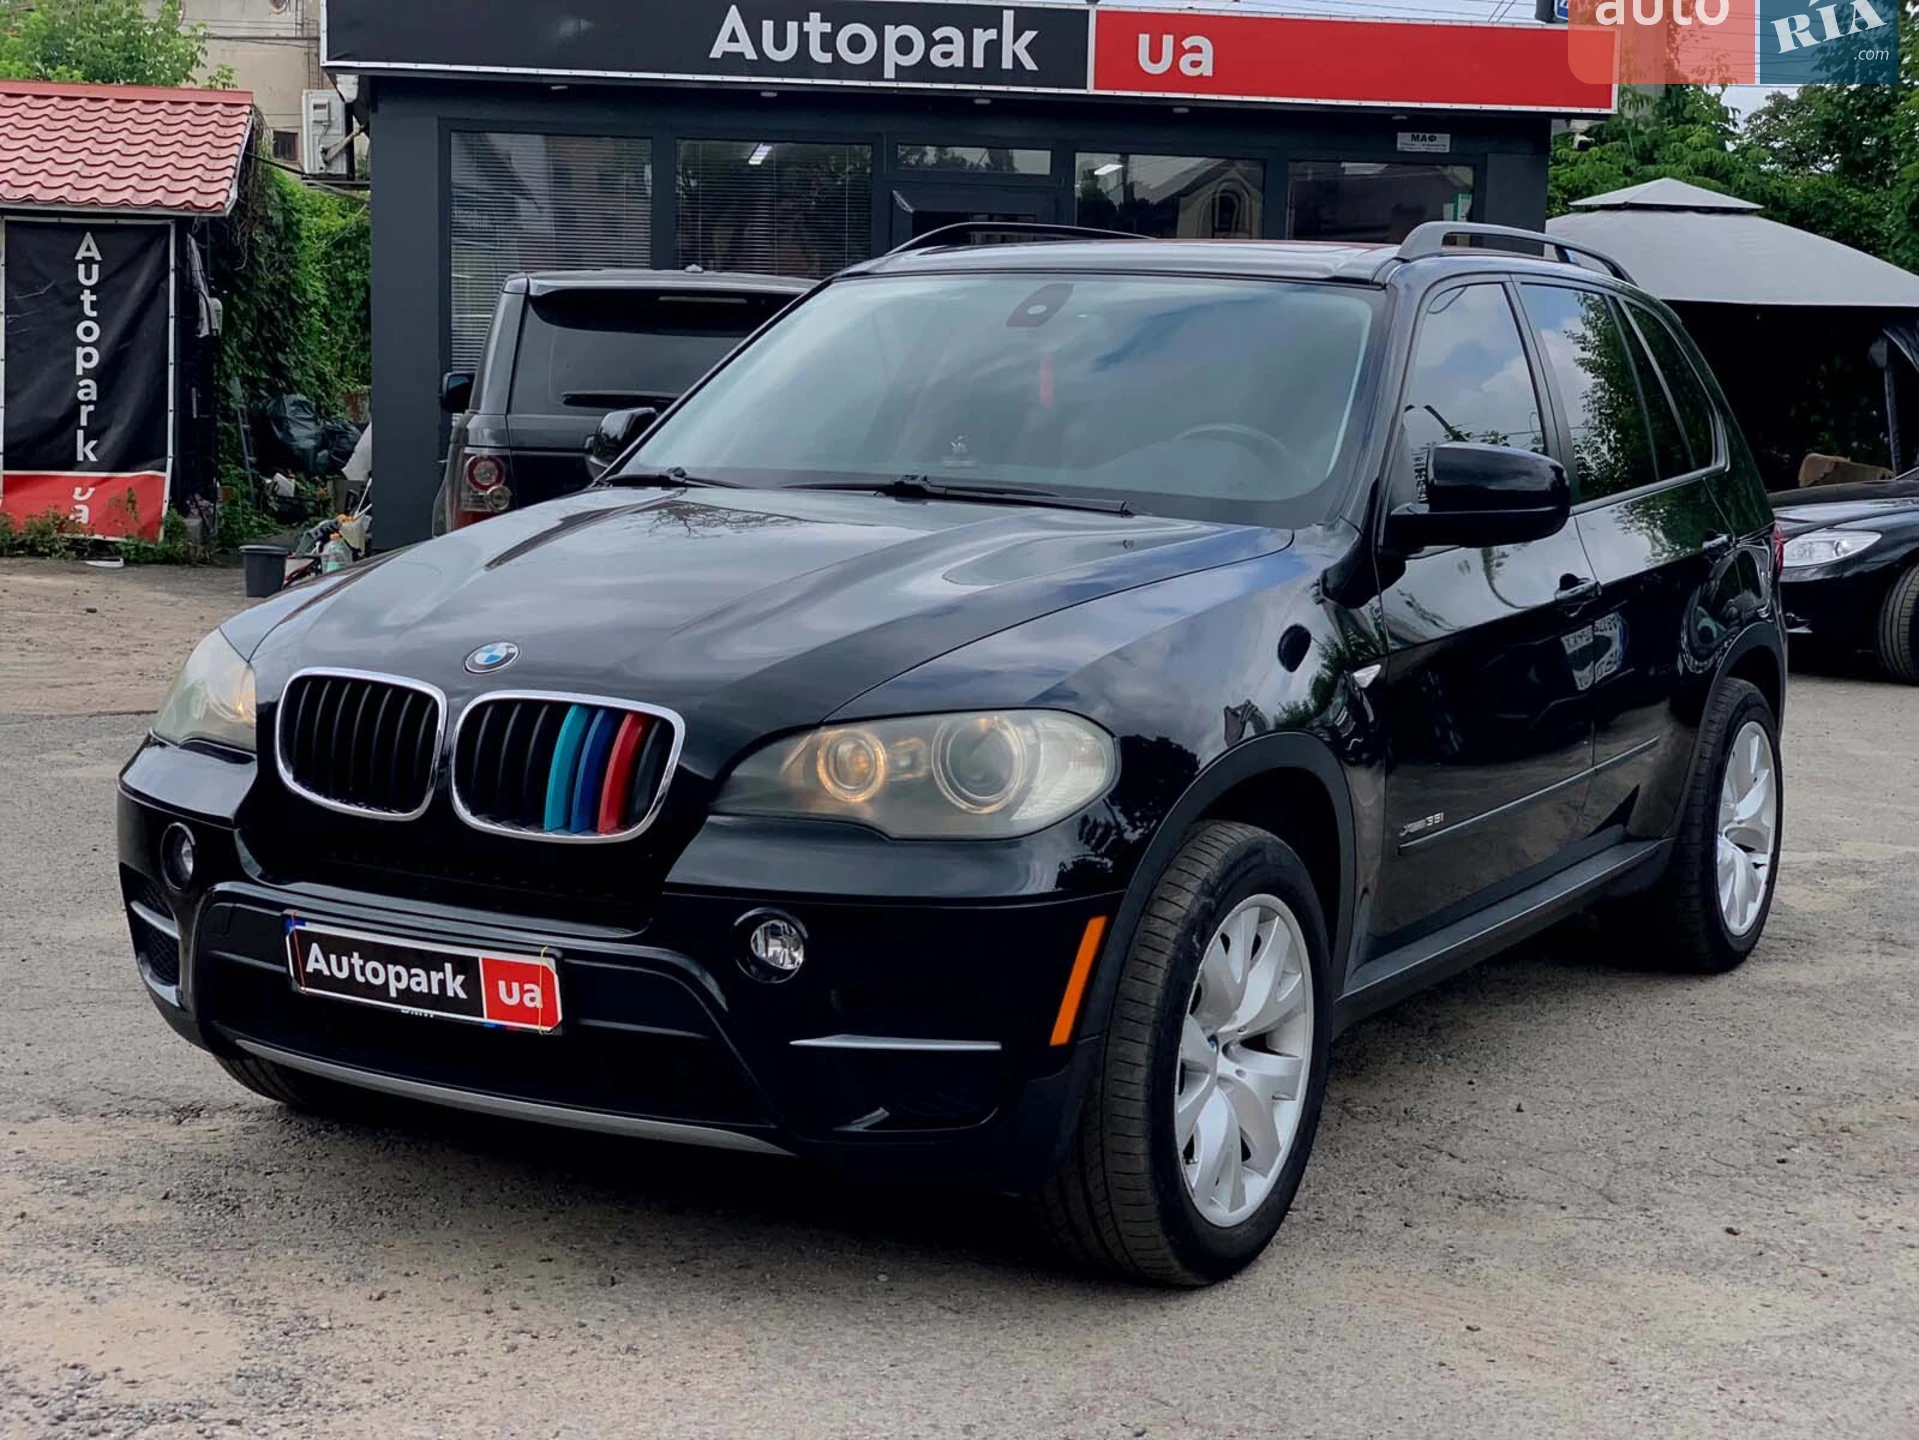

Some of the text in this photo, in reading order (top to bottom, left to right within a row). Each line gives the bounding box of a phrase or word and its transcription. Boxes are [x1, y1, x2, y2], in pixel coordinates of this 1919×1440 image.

[709, 4, 1215, 79] Autopark ua
[75, 231, 102, 463] Autopark
[305, 942, 545, 1008] Autopark ua
